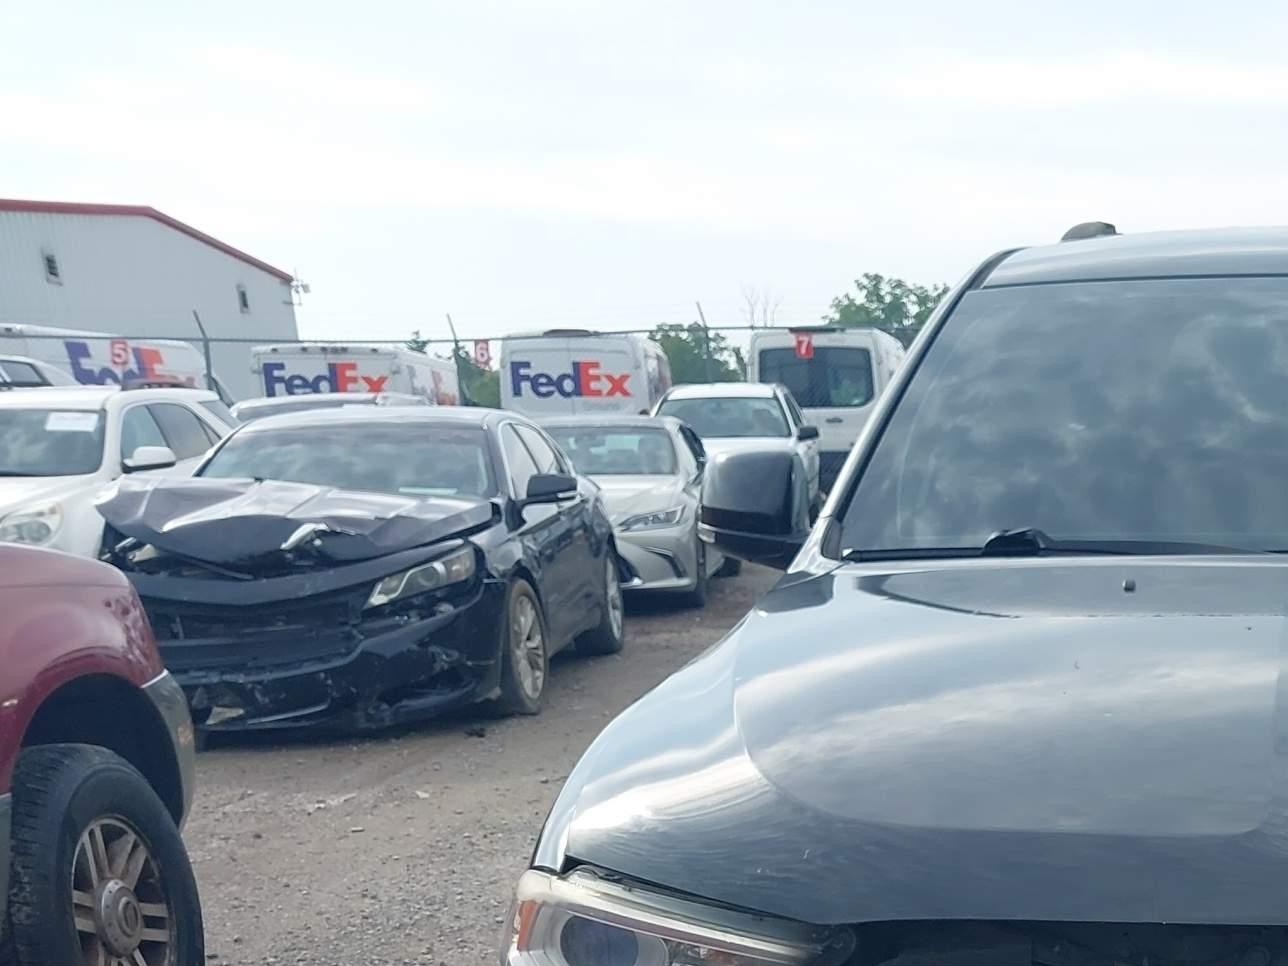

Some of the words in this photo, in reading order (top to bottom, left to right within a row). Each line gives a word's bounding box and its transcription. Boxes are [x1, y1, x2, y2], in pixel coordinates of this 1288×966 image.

[111, 340, 129, 364] 5
[476, 344, 488, 363] 6
[797, 336, 809, 355] 7
[263, 362, 388, 397] FedEx
[510, 361, 632, 398] FedEx
